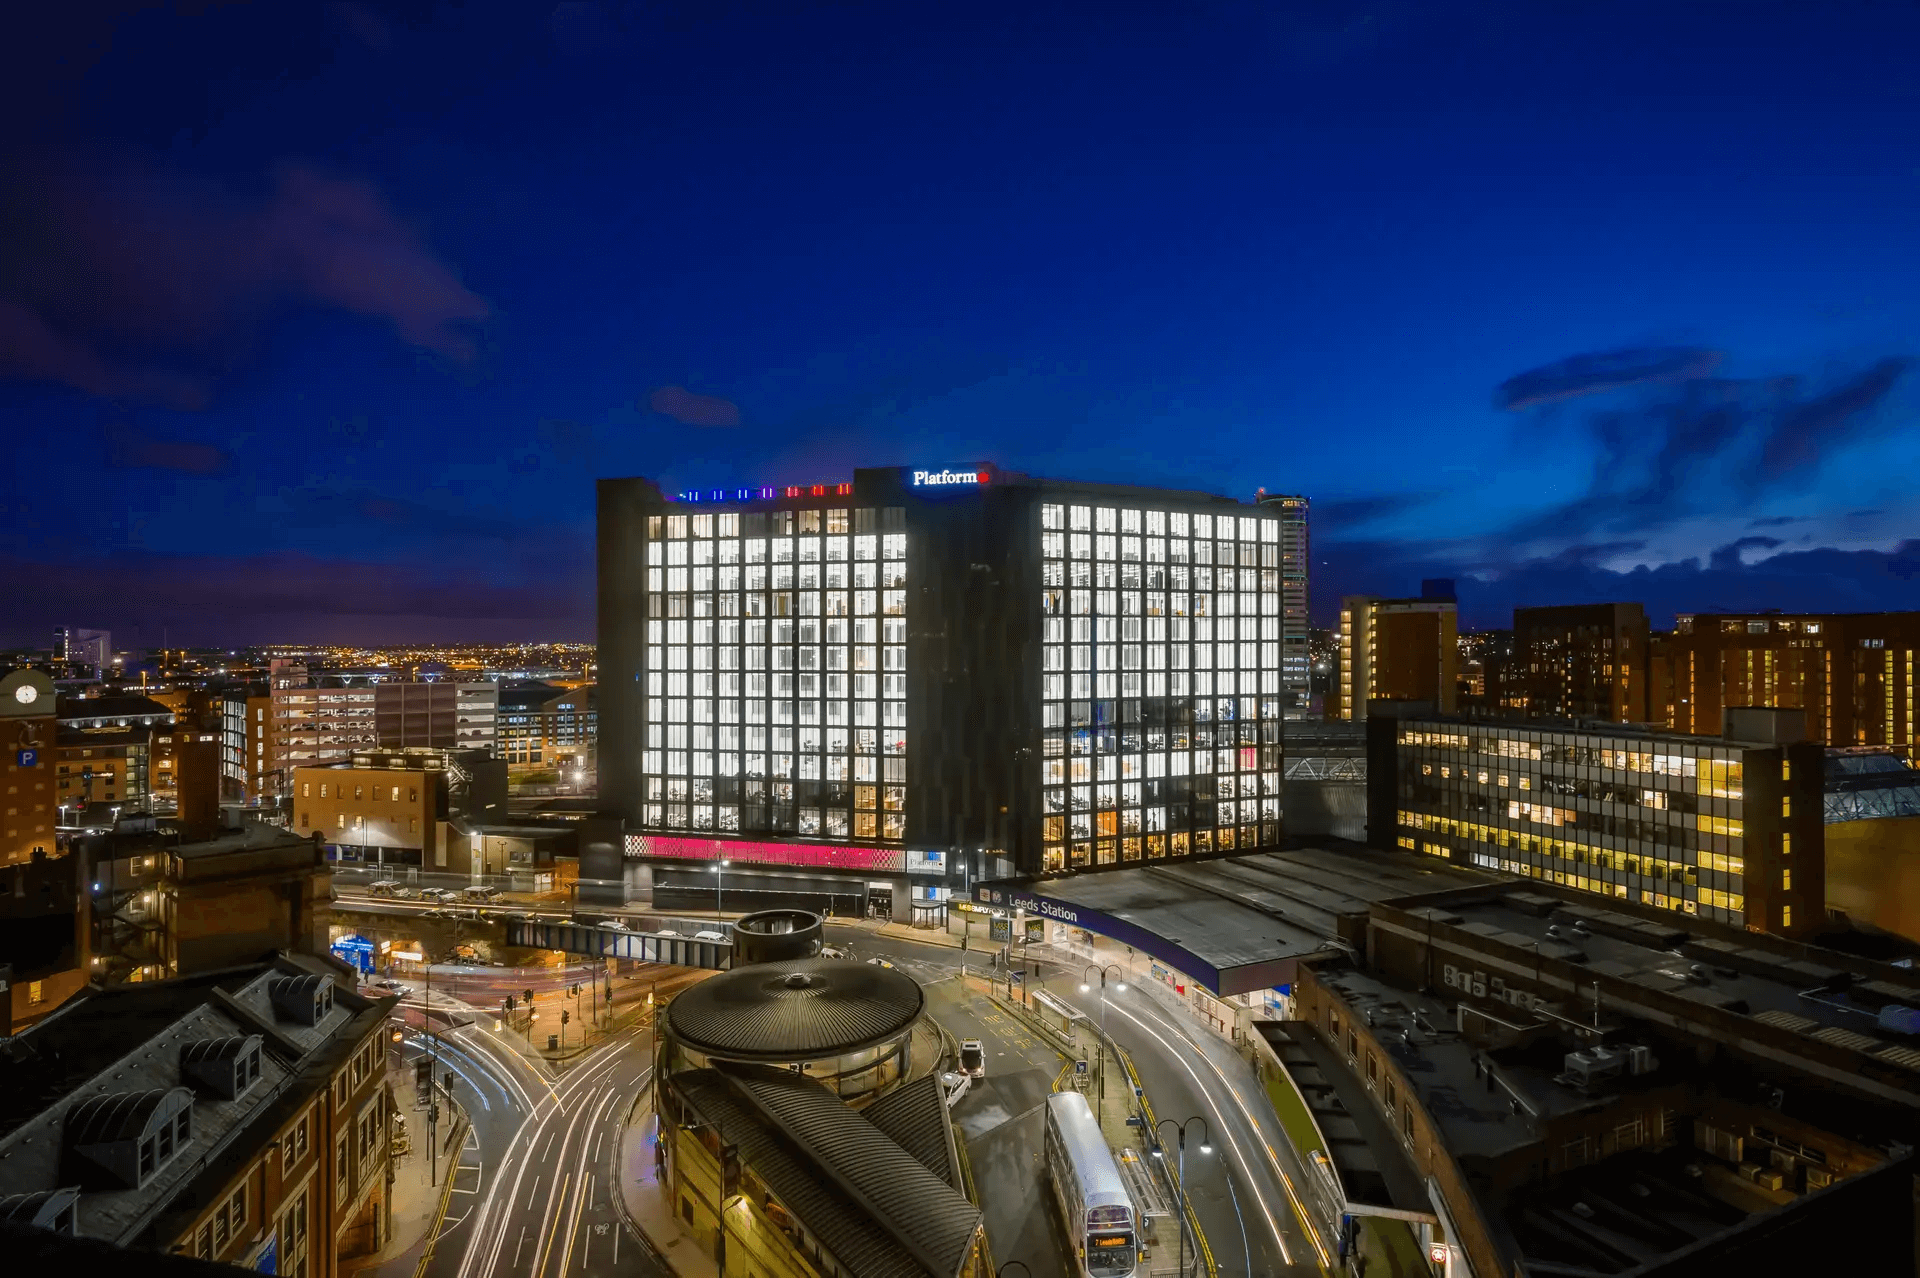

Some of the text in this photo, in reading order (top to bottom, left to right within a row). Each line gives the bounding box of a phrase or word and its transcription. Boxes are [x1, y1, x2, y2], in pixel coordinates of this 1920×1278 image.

[914, 470, 978, 485] Platform
[23, 752, 33, 765] P
[1009, 894, 1078, 922] Leeds Station
